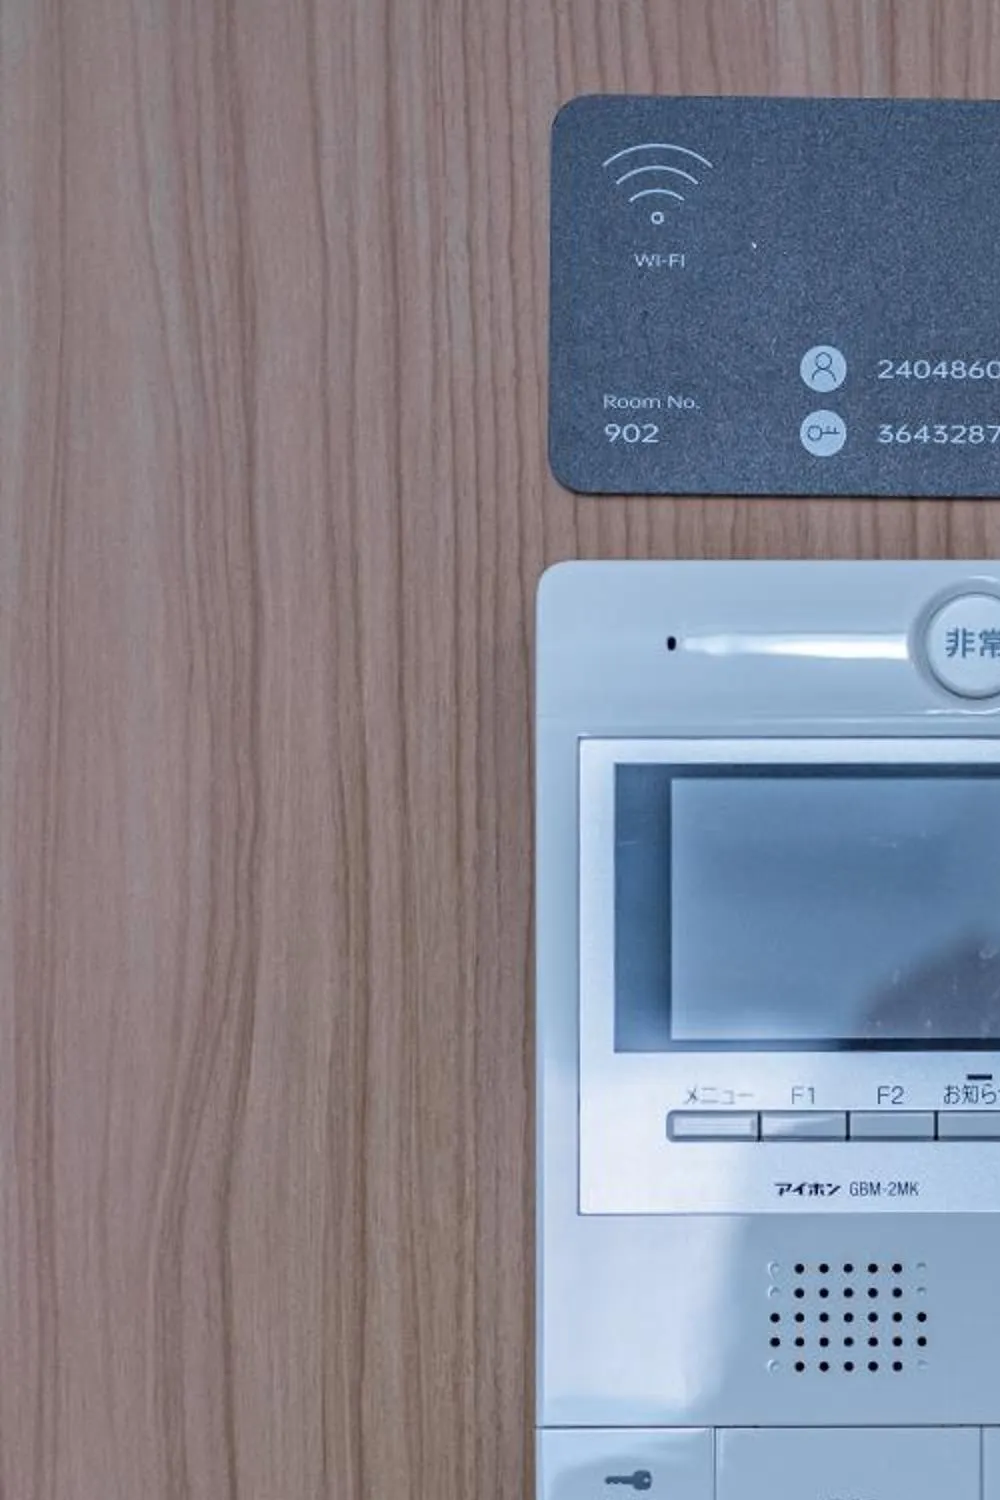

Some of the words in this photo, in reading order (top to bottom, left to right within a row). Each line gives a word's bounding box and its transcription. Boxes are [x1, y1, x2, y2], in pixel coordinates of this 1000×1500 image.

[602, 394, 661, 409] Room
[667, 395, 701, 409] No.
[604, 423, 660, 443] 902
[683, 1085, 756, 1105] メニュー
[791, 1086, 816, 1105] F1
[877, 1086, 905, 1105] F2
[774, 1182, 842, 1197] アイホン
[849, 1182, 919, 1197] GBM-2MK
